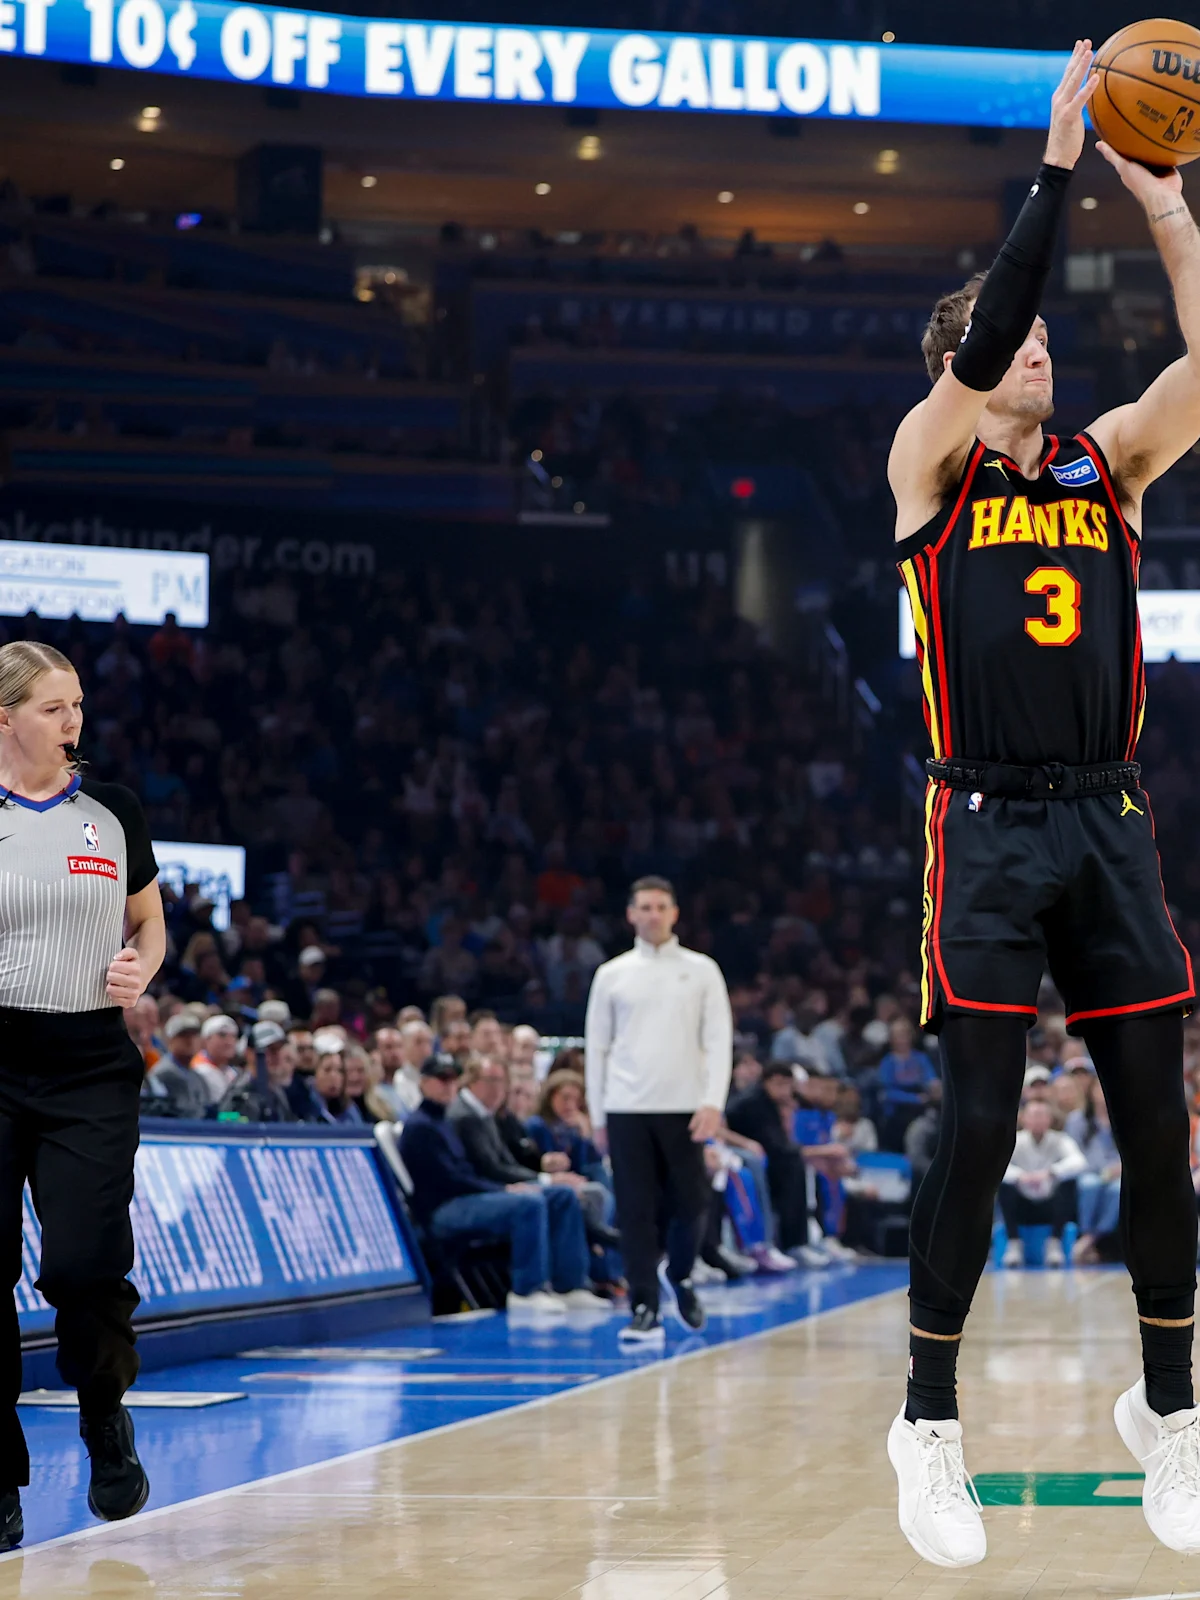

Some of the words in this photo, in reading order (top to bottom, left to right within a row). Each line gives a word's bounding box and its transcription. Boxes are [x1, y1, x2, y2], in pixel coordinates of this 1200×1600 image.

[84, 0, 198, 71] 10¢
[220, 7, 342, 87] OFF
[365, 22, 590, 103] EVERY
[608, 33, 881, 116] GALLON
[1024, 566, 1081, 646] 3
[69, 859, 117, 877] Emirates
